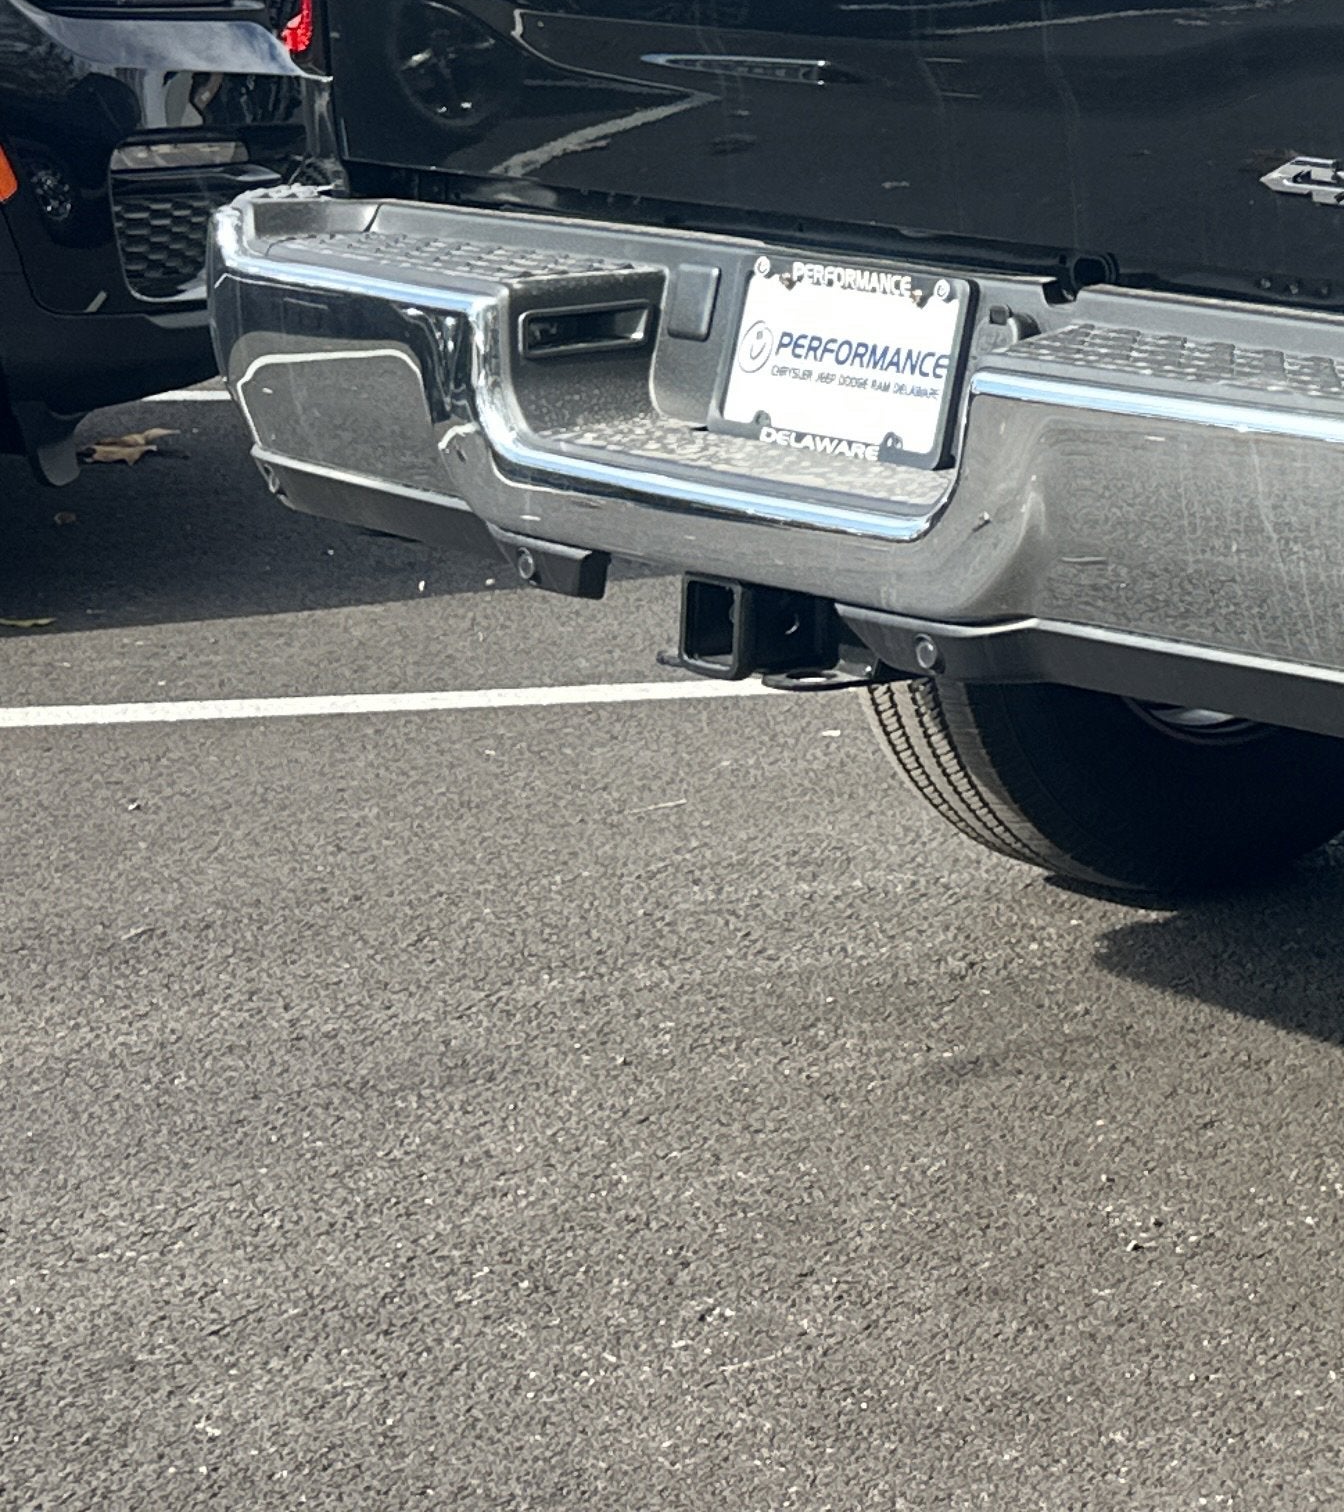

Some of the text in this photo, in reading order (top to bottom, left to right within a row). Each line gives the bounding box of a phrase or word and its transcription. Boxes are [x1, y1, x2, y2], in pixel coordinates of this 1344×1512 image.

[791, 261, 912, 296] PERFORMANCE
[775, 331, 950, 379] PERFORMANCE
[759, 426, 880, 461] DELAWARE
